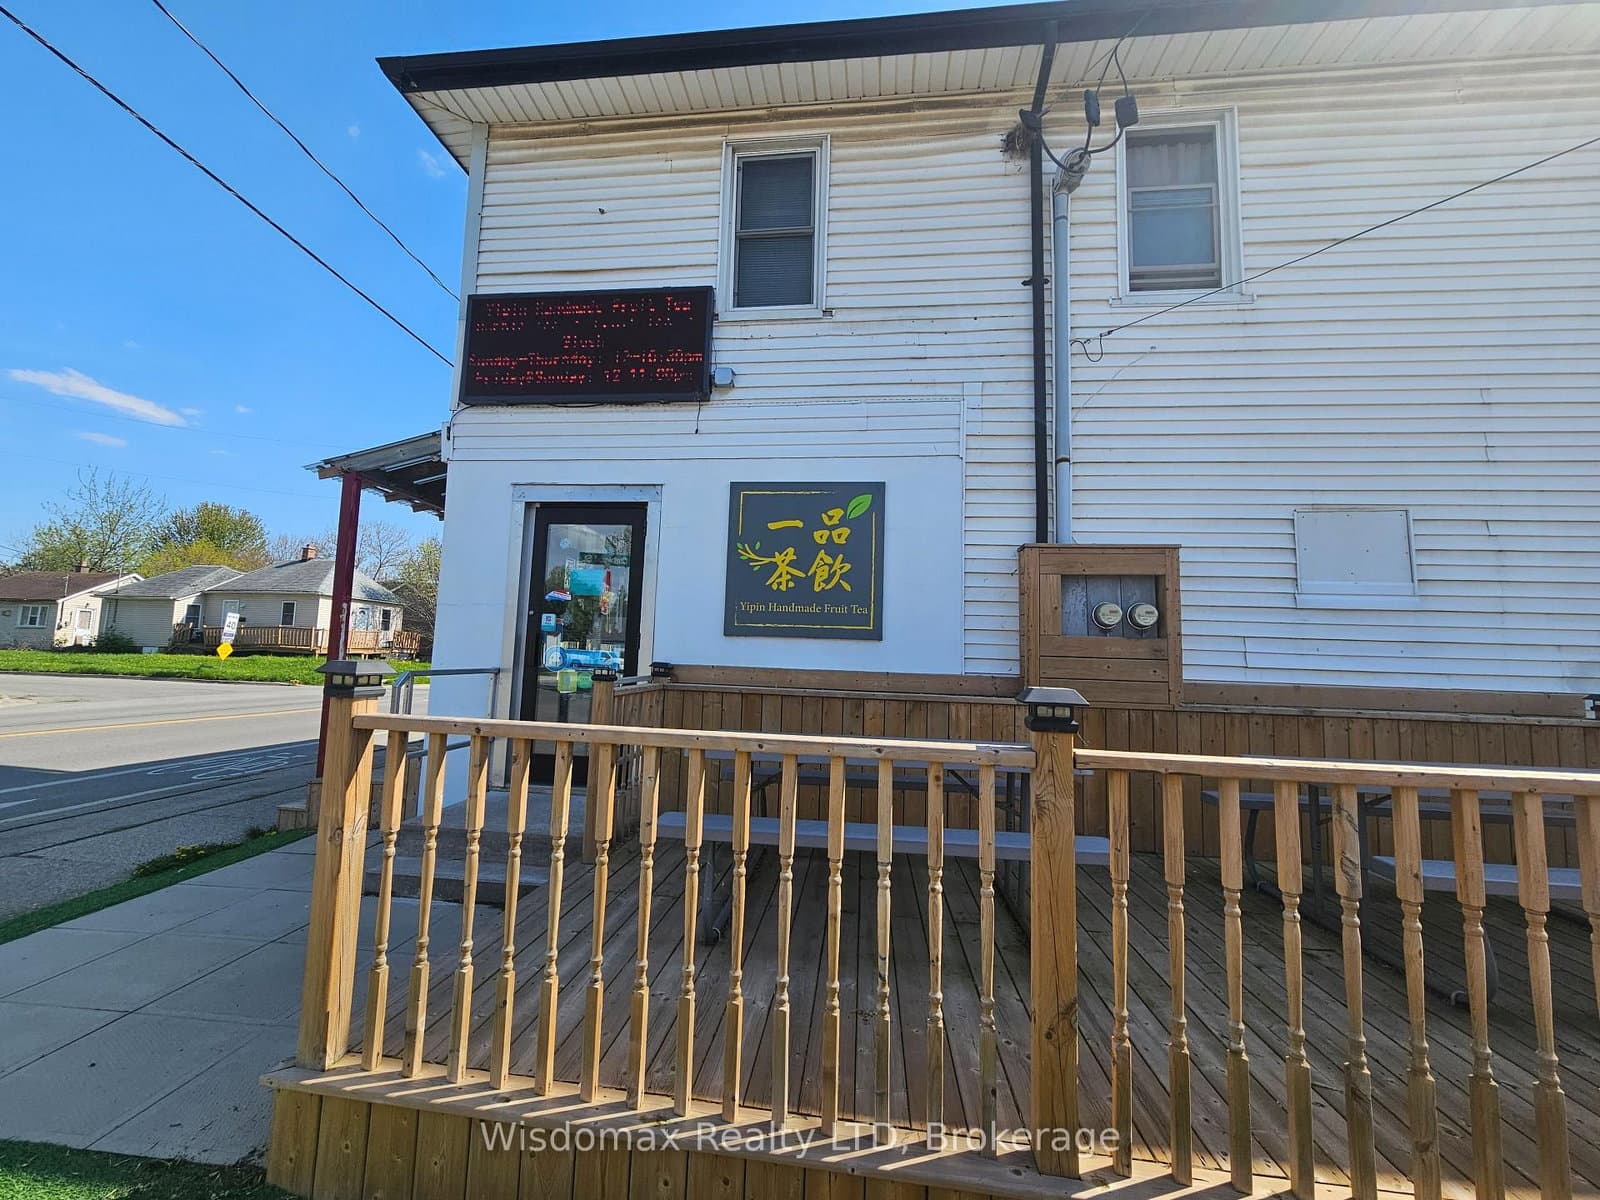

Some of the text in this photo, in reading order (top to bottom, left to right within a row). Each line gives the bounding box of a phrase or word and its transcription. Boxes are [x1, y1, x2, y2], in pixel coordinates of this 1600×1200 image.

[767, 507, 852, 545] 一品
[764, 546, 852, 592] 茶飲
[740, 602, 868, 614] Yipin Handmade Fruit Tea
